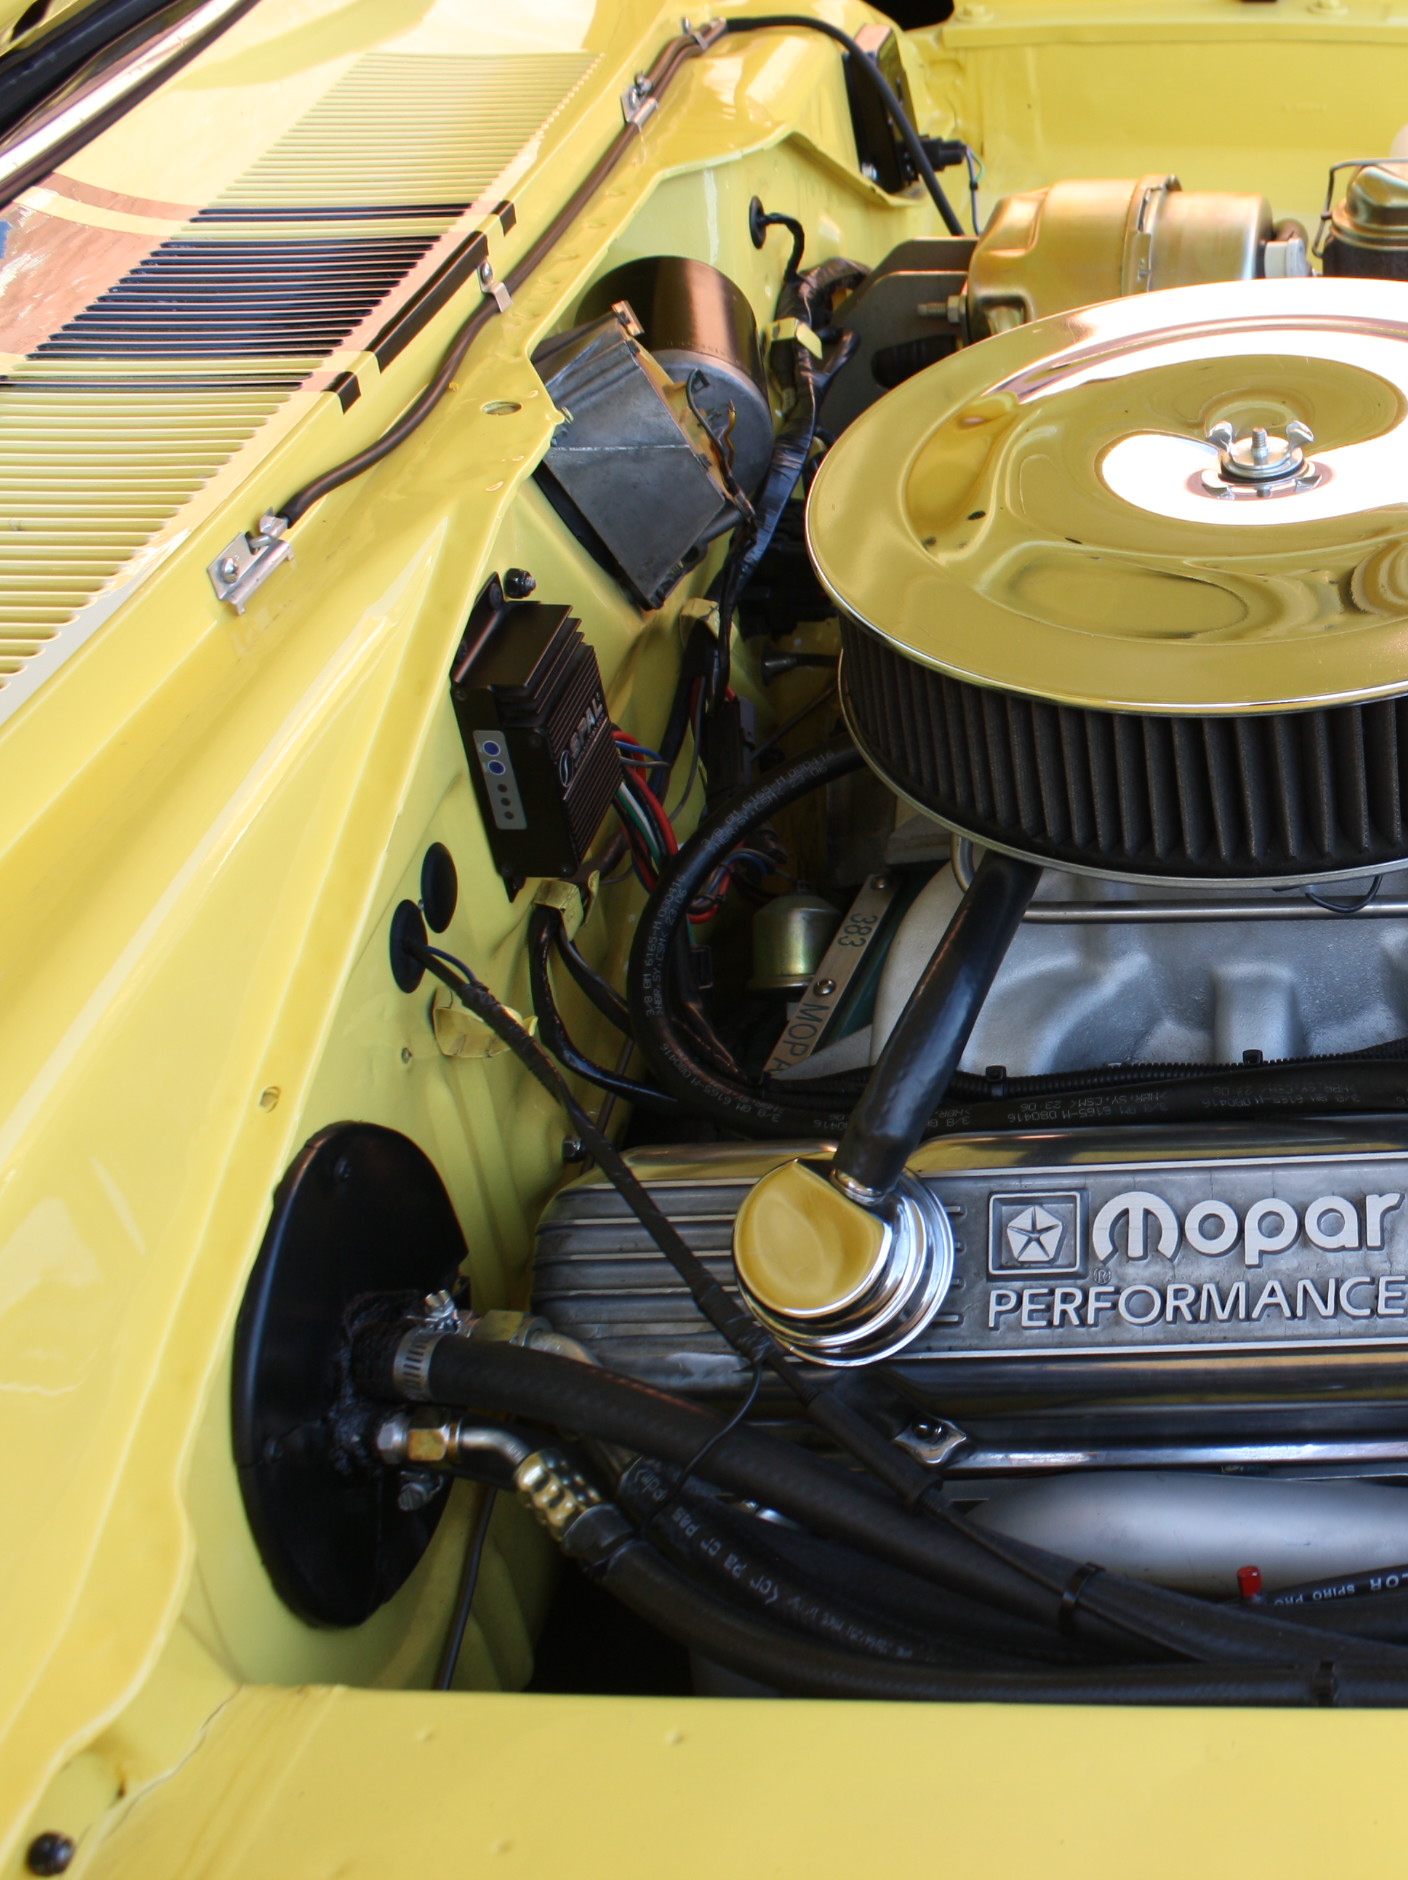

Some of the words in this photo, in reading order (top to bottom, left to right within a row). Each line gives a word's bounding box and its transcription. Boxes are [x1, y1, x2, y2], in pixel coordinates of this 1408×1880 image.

[838, 913, 878, 948] 383
[767, 1002, 830, 1073] MOPA
[1092, 1191, 1404, 1266] Mopar
[988, 1275, 1407, 1330] PERFORMANCE
[1311, 1583, 1356, 1600] SPIRO
